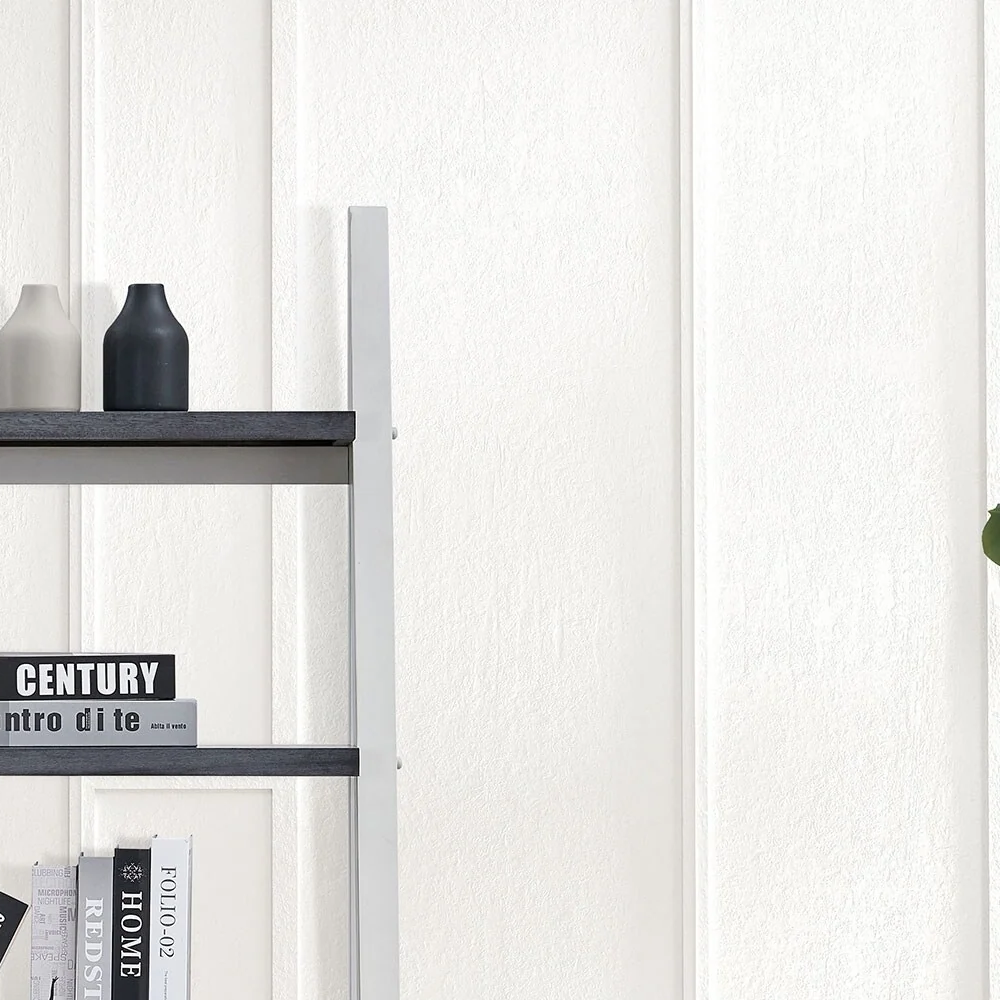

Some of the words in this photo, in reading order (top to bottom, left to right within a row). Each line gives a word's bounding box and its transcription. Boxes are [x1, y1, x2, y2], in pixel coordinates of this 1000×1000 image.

[16, 662, 159, 697] CENTURY
[113, 708, 140, 731] te
[120, 891, 143, 977] HOME
[159, 866, 177, 958] FOLIO-02
